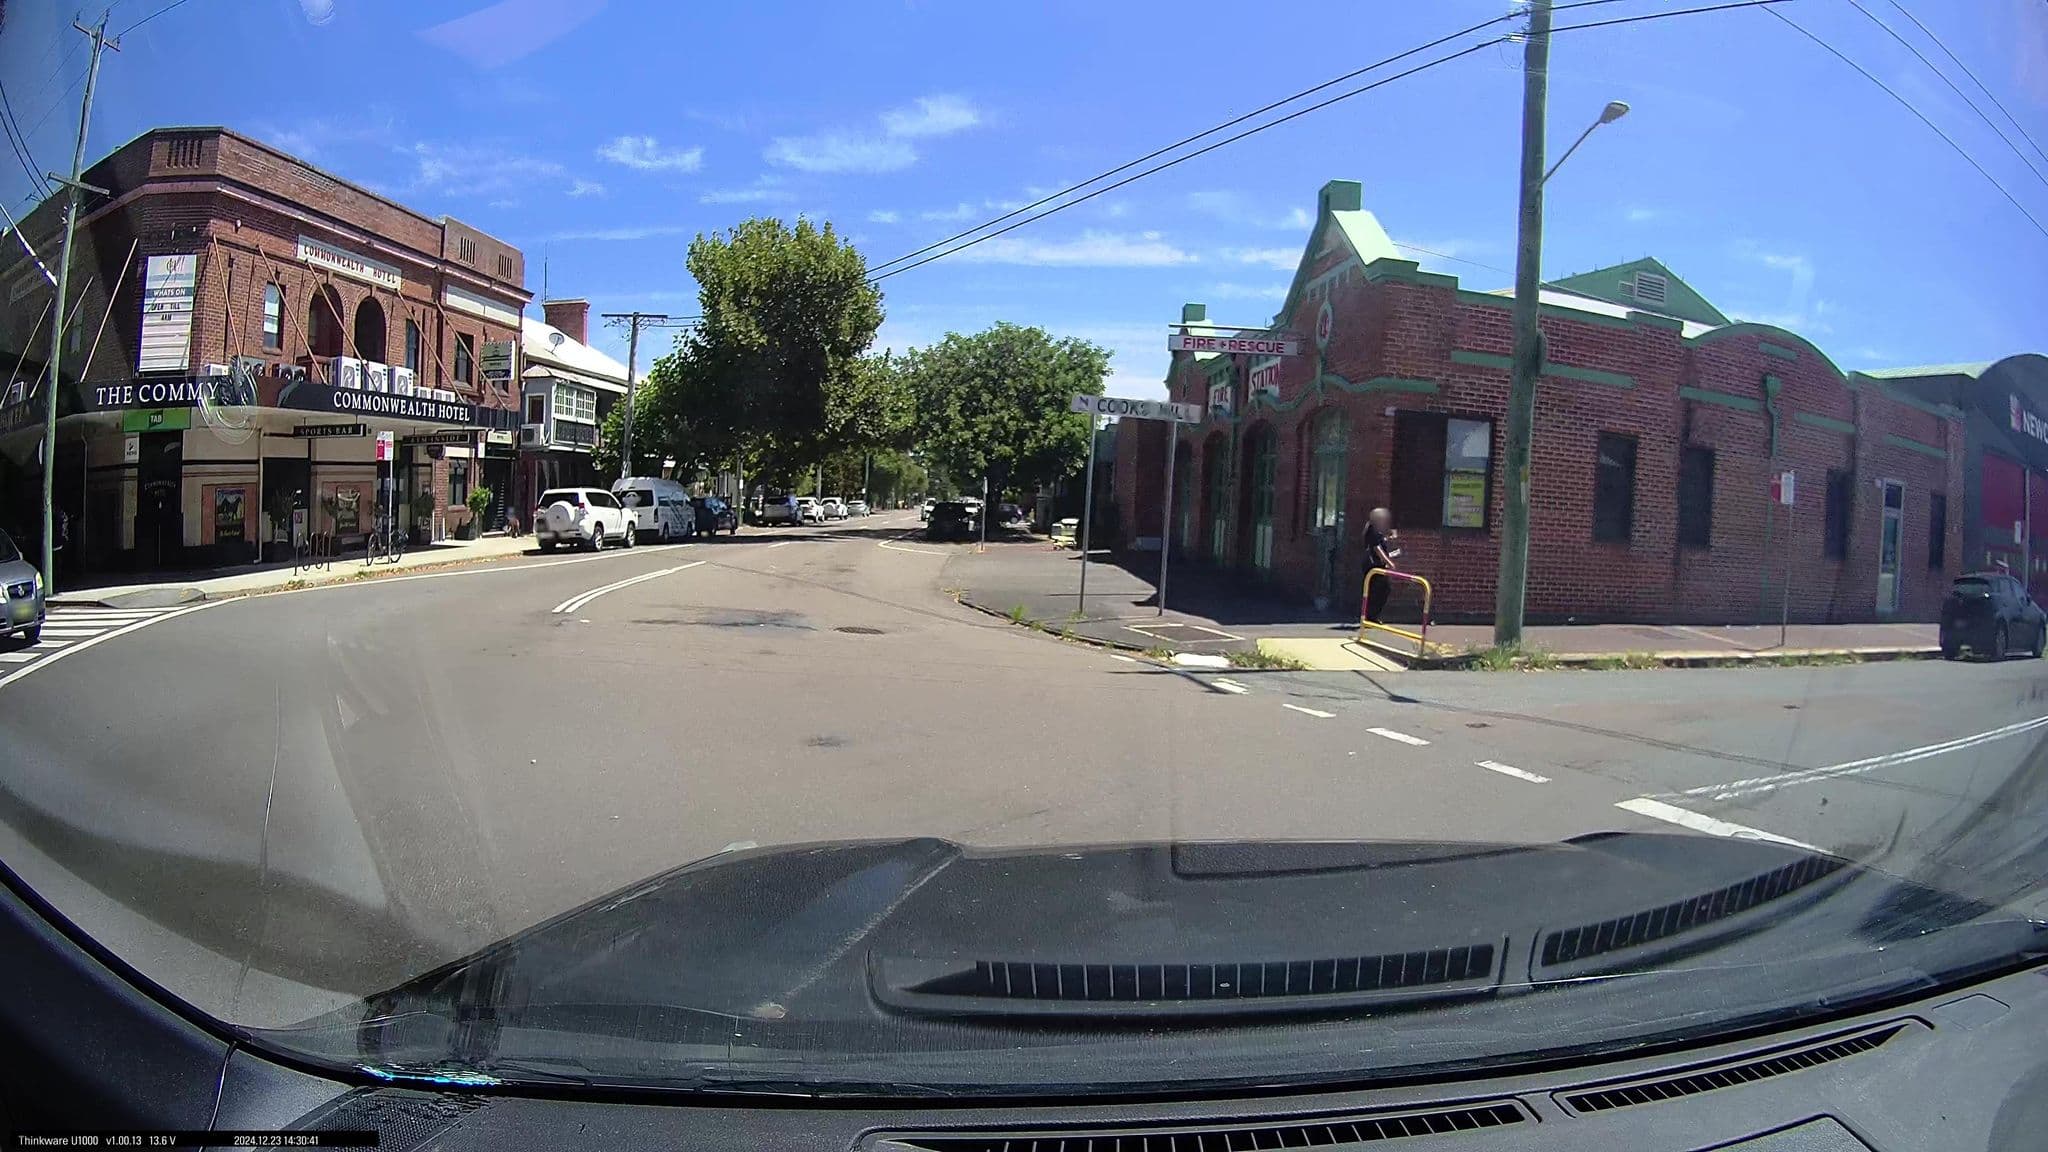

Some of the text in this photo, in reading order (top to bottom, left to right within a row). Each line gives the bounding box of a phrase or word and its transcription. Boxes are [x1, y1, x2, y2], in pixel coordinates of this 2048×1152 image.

[304, 244, 397, 284] COMMONWEALTH HOTEL
[153, 288, 186, 297] WHATS ON
[1183, 337, 1216, 350] FIRE
[1229, 340, 1285, 353] RESCUE
[1252, 363, 1281, 392] STATION
[96, 382, 219, 405] THE COMMY
[1214, 386, 1229, 403] FIRE
[333, 391, 470, 421] COMMONWEALTH HOTEL
[150, 415, 162, 423] TAB
[300, 426, 353, 436] SPORTS BAR
